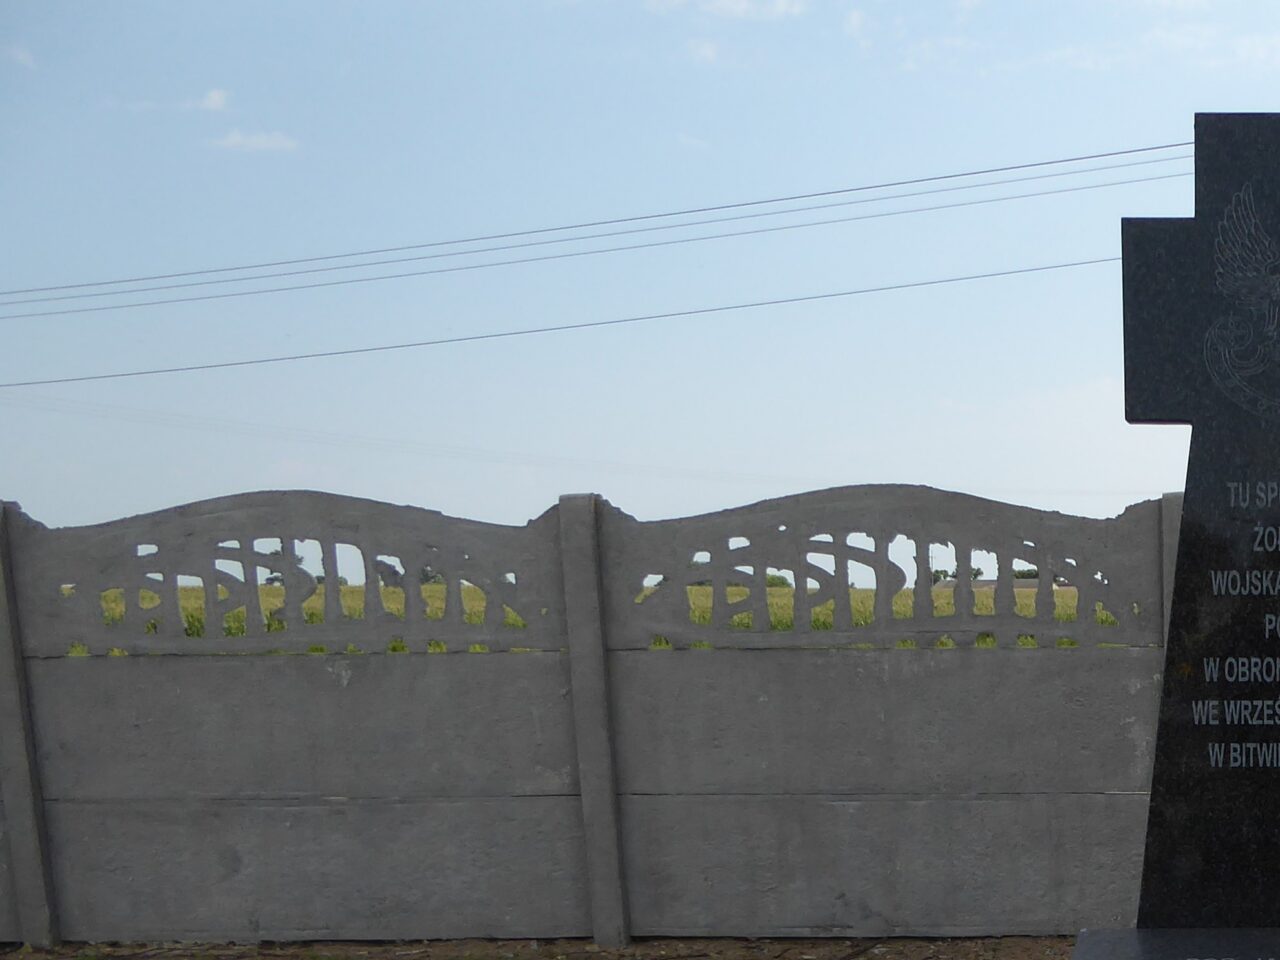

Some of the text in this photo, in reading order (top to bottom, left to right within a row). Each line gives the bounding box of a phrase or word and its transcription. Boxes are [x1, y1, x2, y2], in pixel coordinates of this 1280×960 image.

[1226, 481, 1250, 508] TU
[1203, 656, 1221, 682] W
[1192, 700, 1219, 725] WE
[1208, 742, 1226, 768] W
